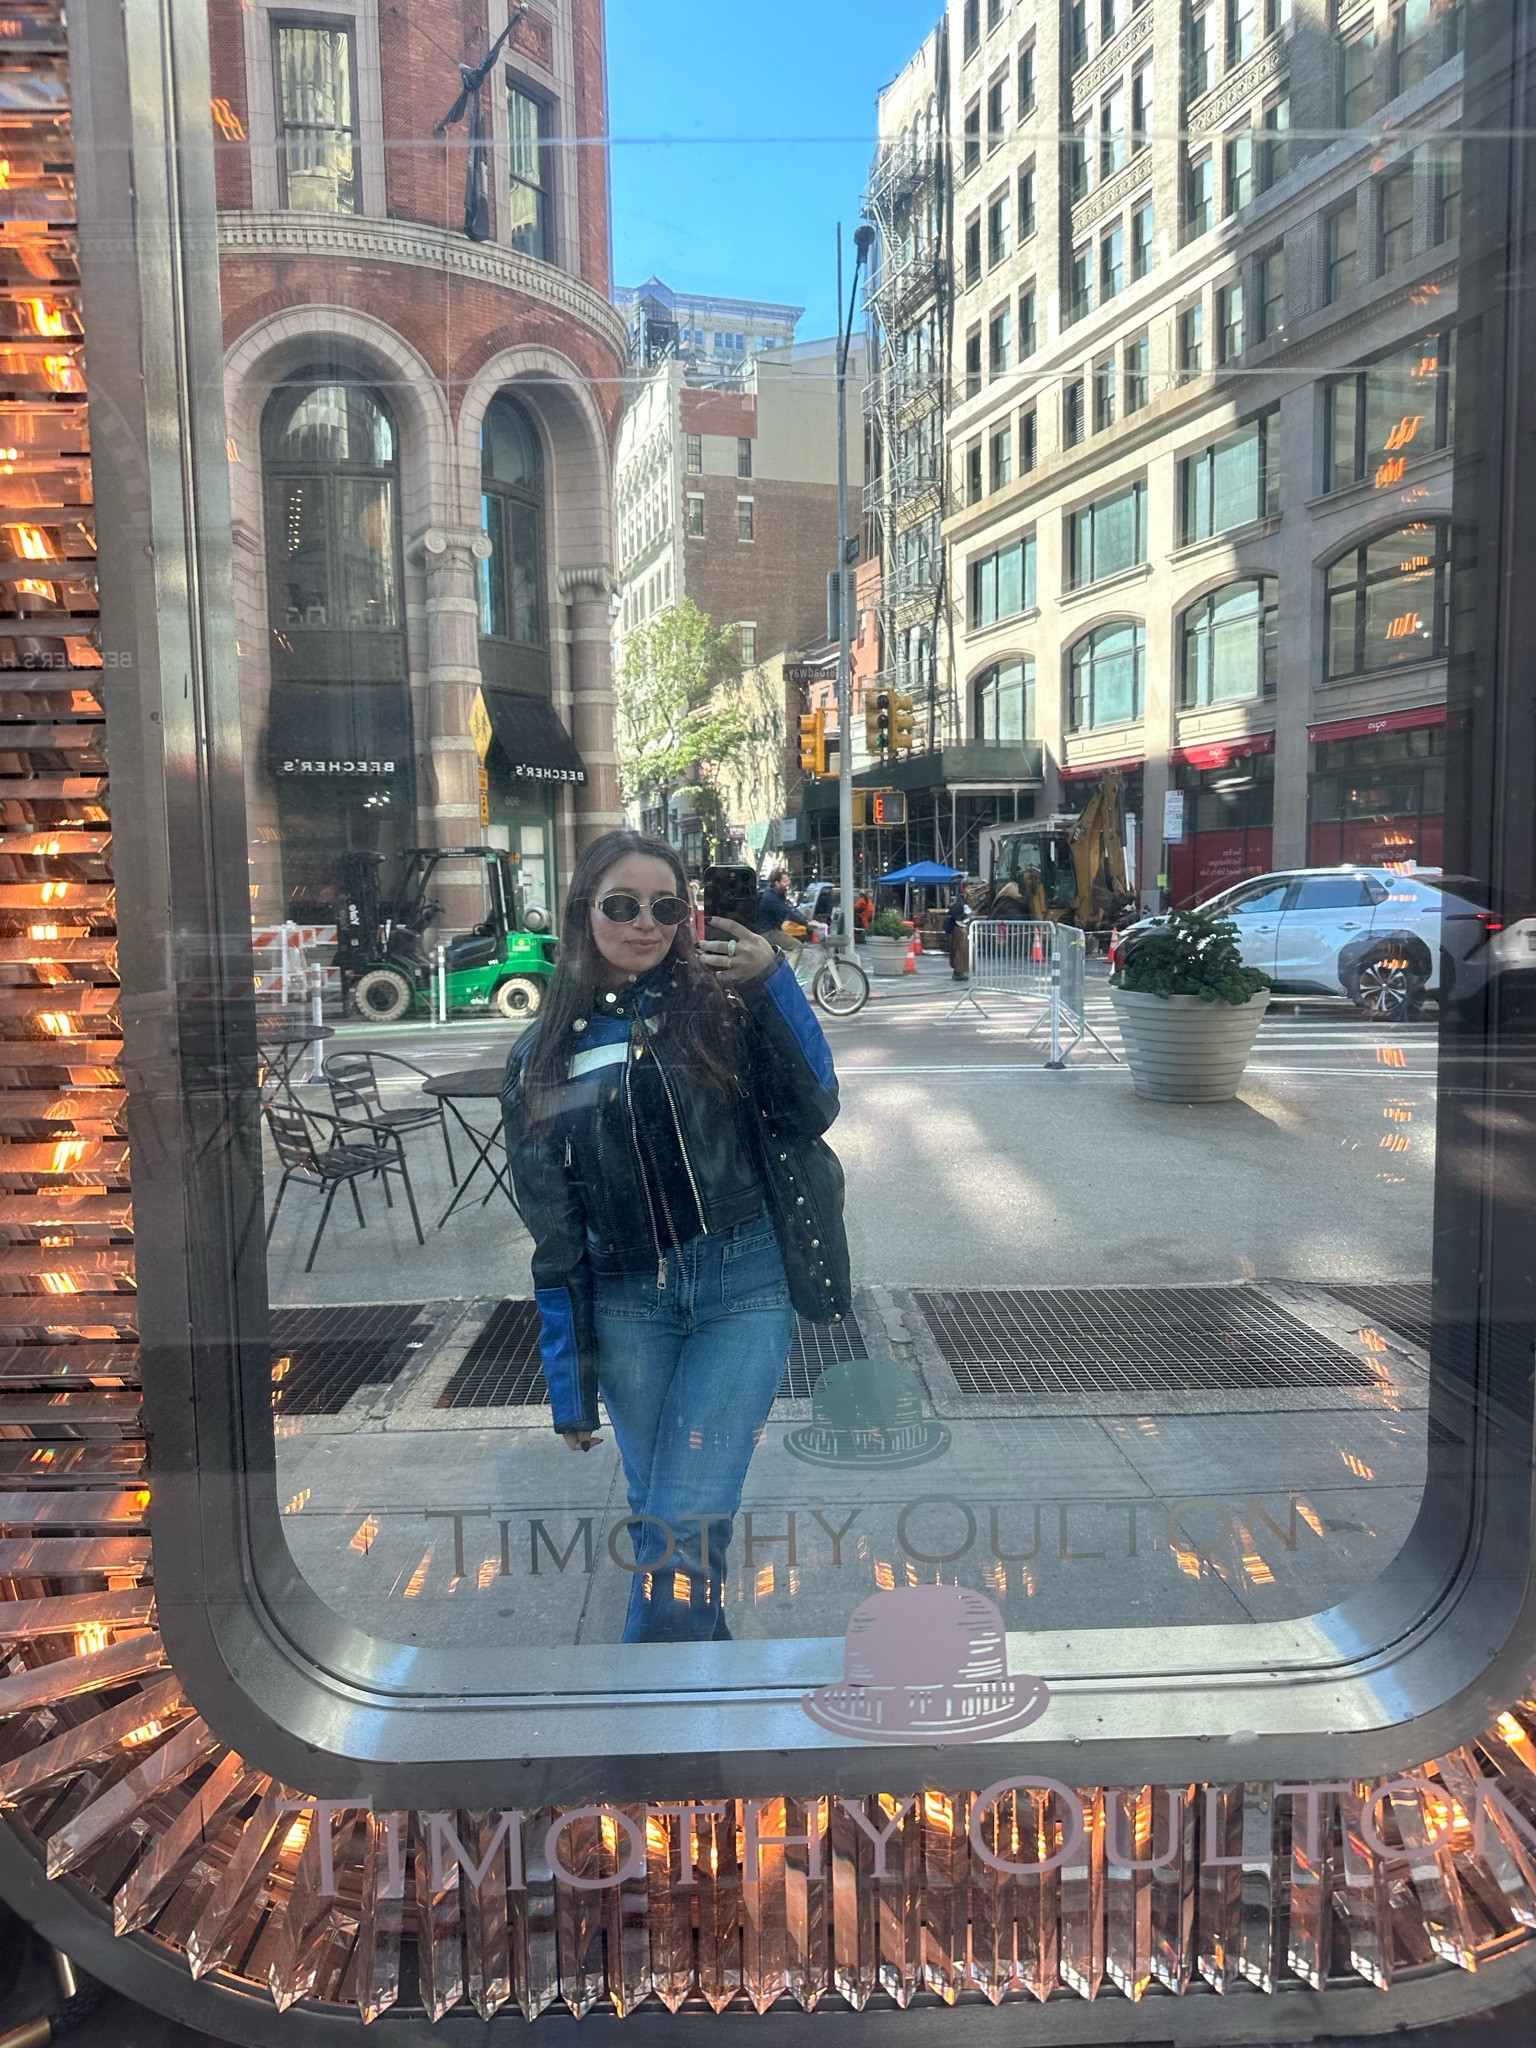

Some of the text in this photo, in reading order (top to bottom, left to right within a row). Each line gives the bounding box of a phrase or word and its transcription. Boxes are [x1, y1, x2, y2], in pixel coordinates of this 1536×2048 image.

[424, 1490, 1303, 1578] TIMOTHY OULTON
[275, 1795, 918, 1898] TIMOTHY
